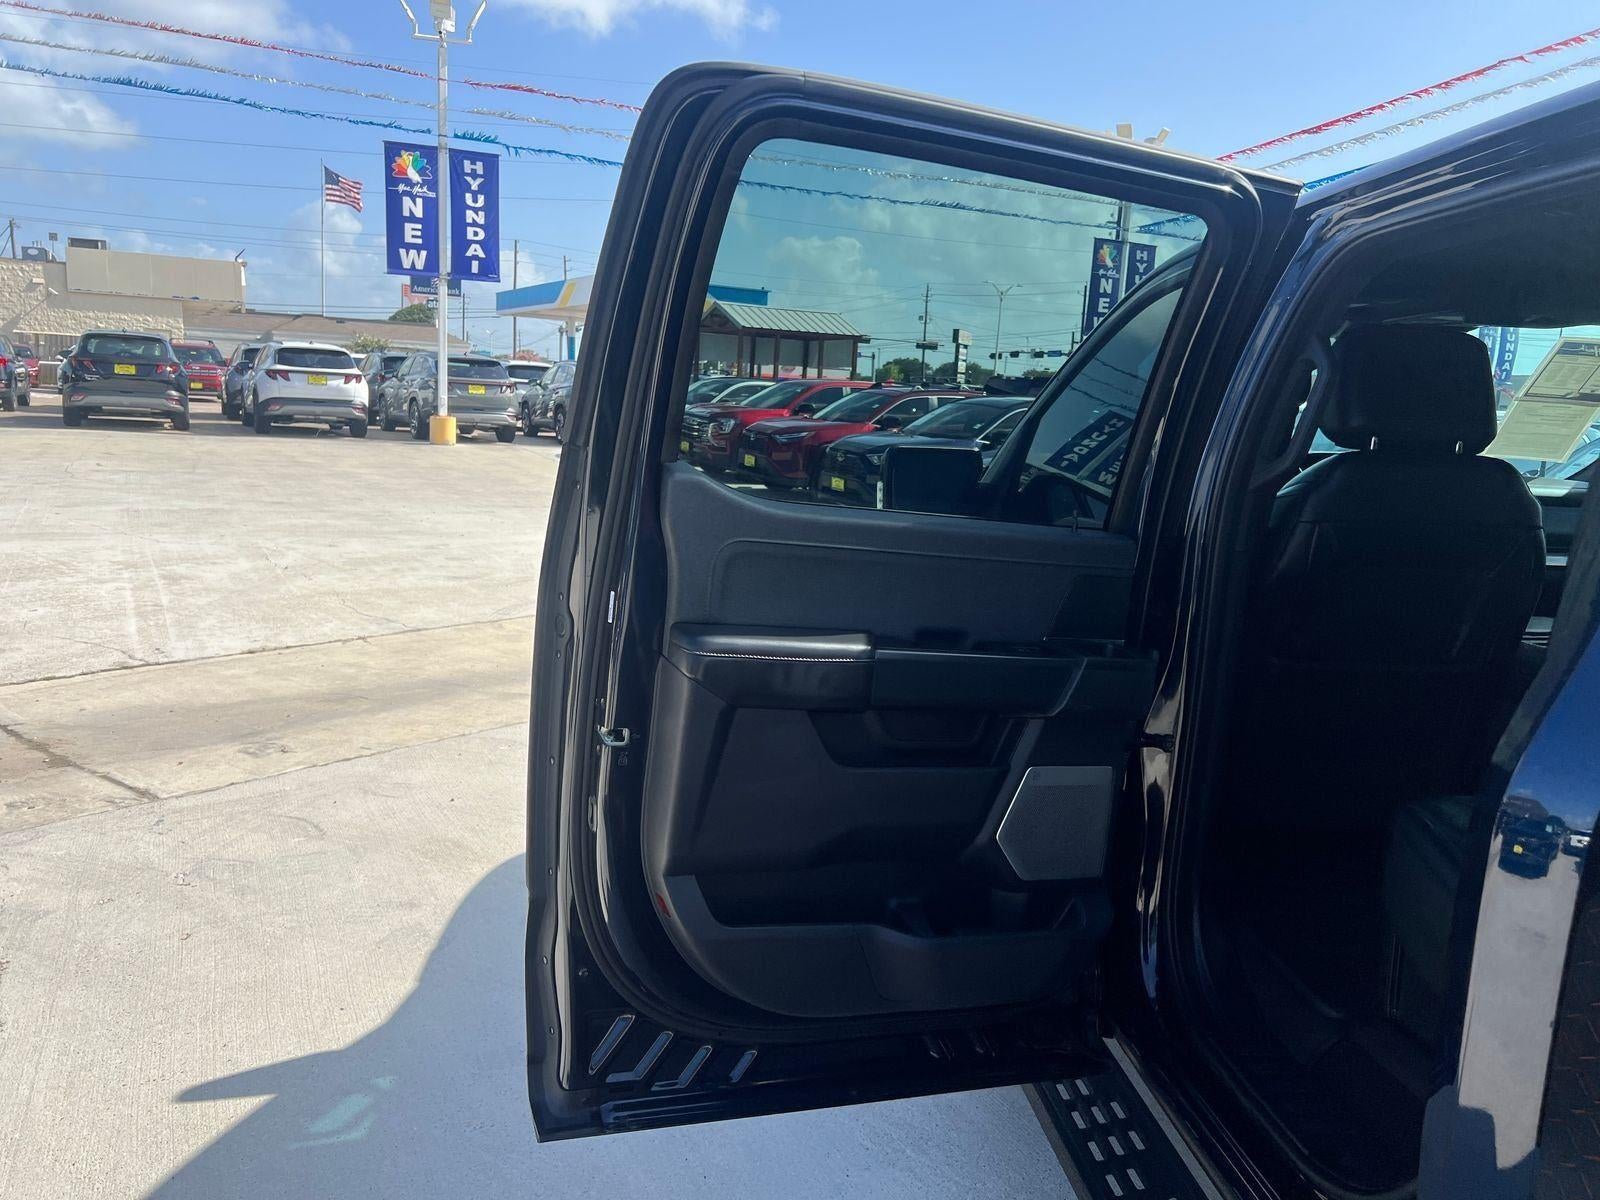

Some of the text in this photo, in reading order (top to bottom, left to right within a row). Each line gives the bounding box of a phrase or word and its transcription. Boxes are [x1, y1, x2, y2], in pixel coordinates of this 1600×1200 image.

[399, 196, 427, 270] NEW
[463, 159, 486, 274] HYUNDAI
[412, 285, 439, 293] Americ
[1502, 328, 1516, 380] UNDAI
